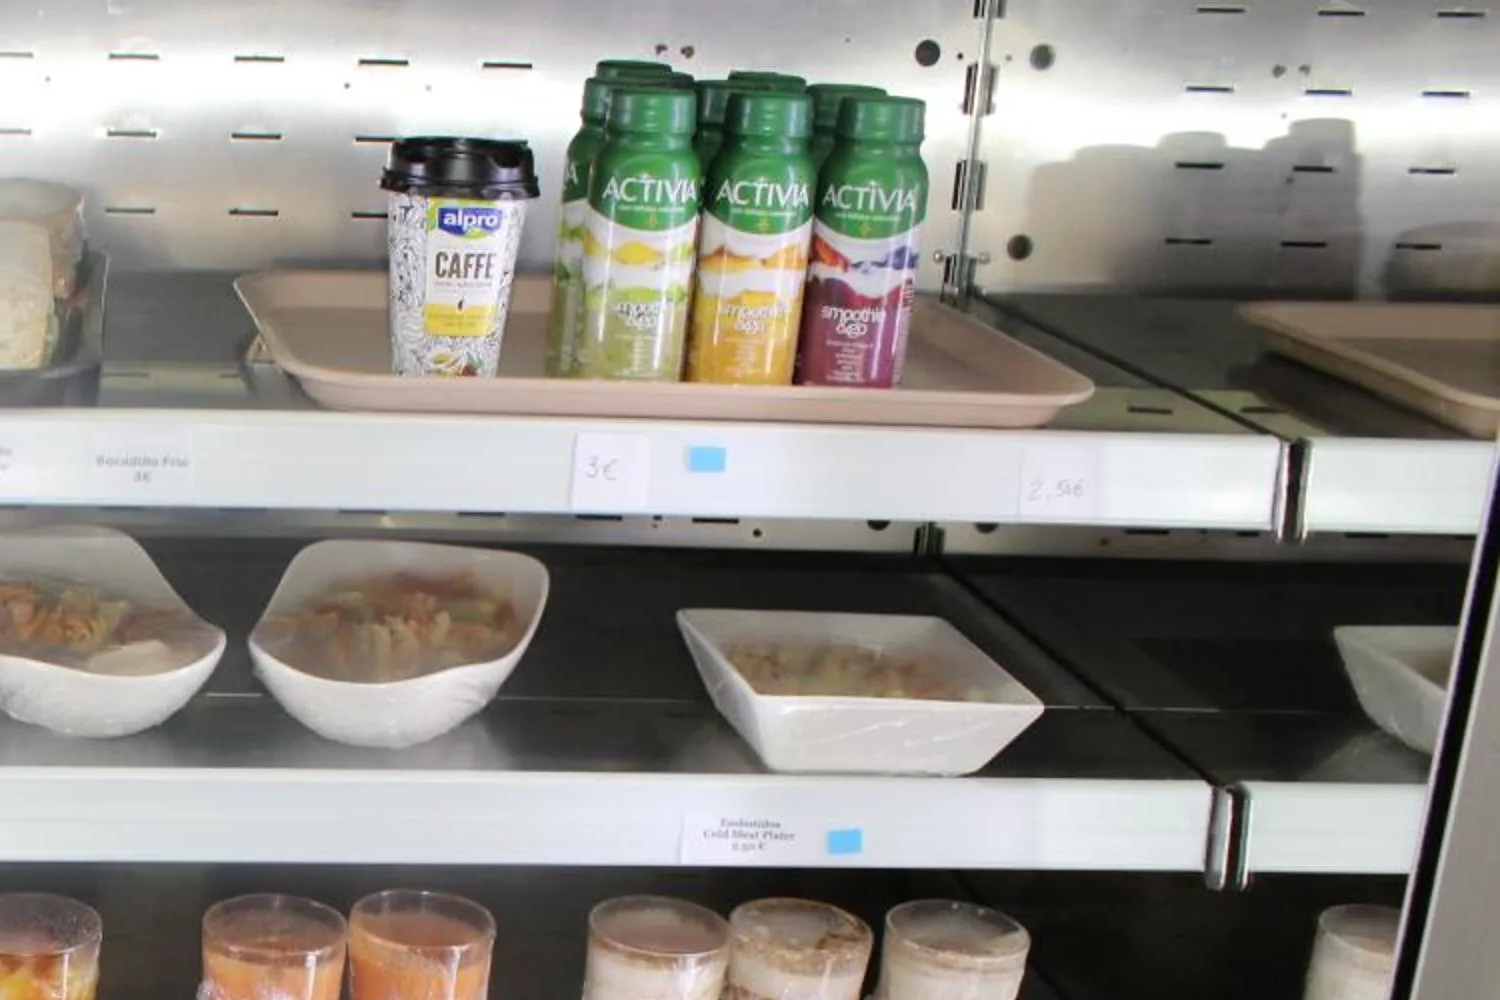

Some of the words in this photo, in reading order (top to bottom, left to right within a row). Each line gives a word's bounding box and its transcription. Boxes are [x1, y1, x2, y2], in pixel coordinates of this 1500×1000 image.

[603, 173, 697, 203] ACTIVIA
[716, 176, 809, 207] ACTIVIA
[822, 181, 917, 212] ACTIVIA
[443, 209, 498, 232] alpro
